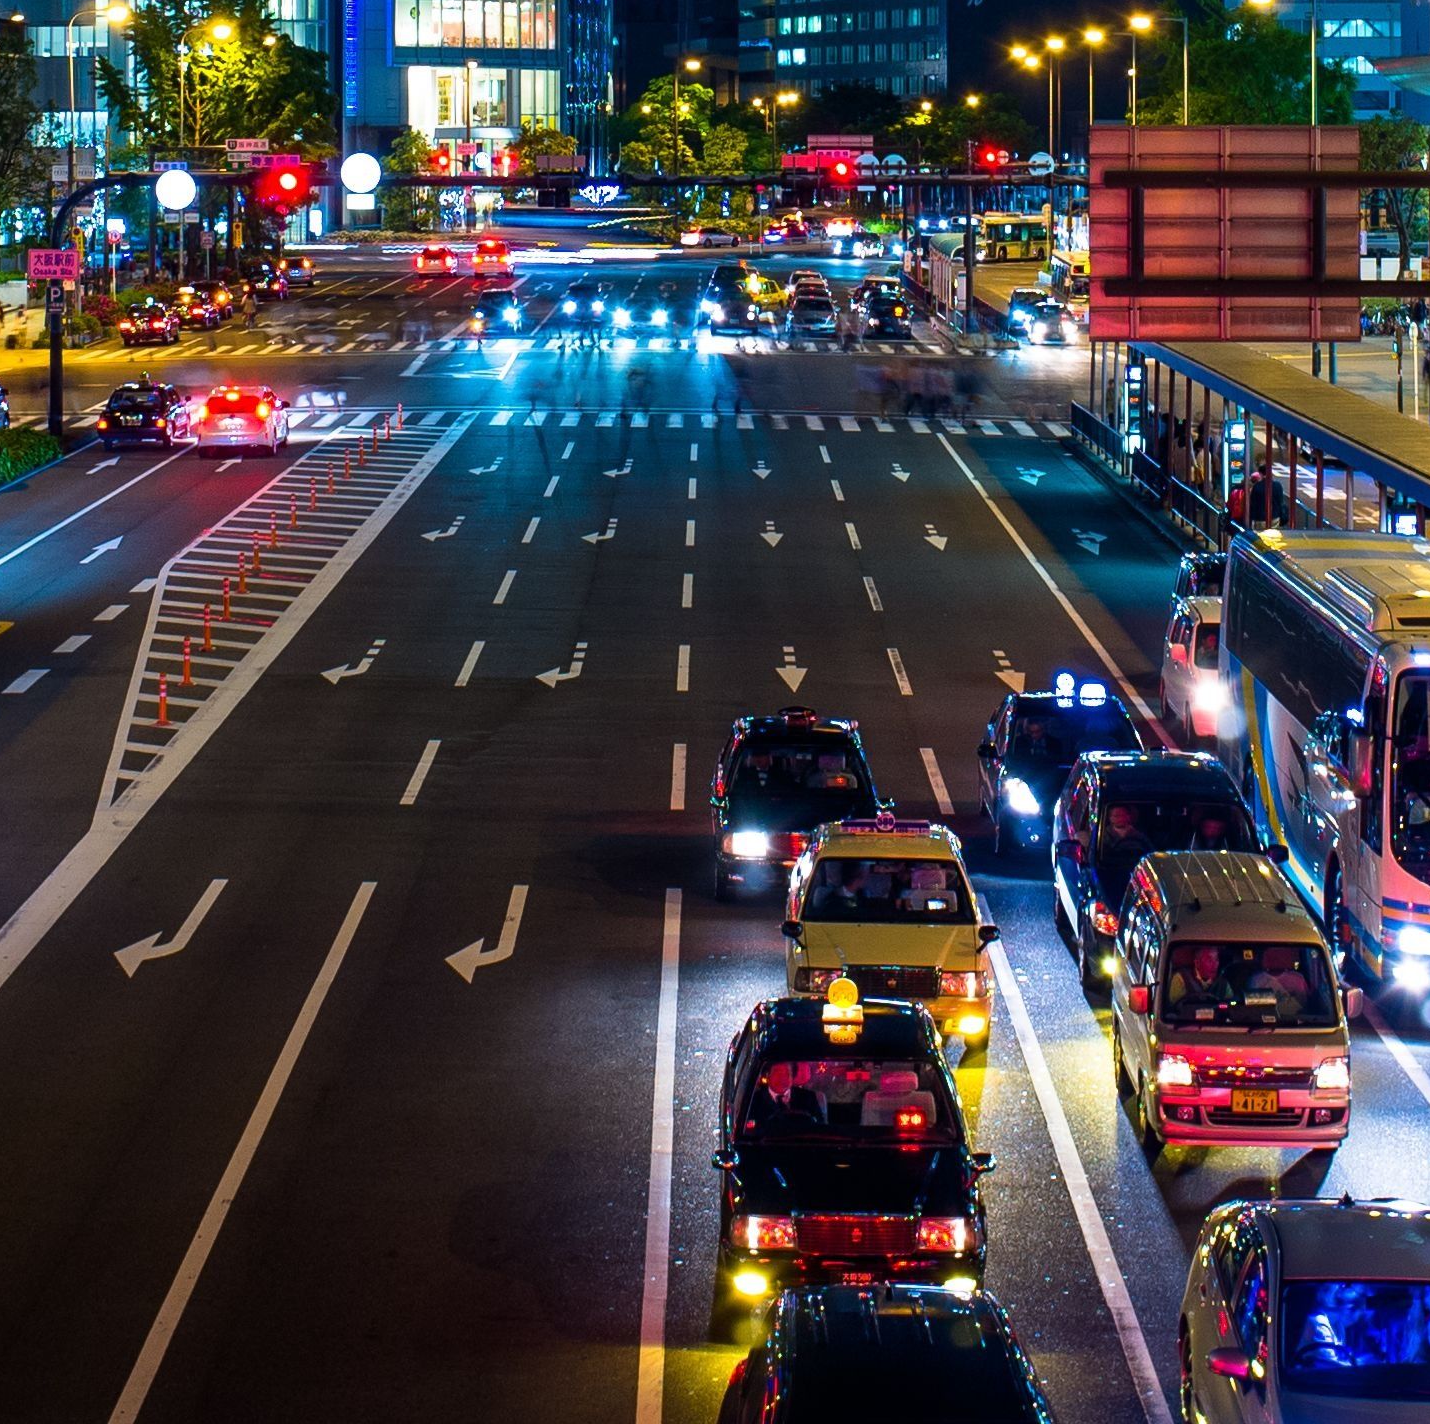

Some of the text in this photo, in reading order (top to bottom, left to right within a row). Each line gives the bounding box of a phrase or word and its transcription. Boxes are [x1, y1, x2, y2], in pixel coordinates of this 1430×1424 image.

[33, 253, 75, 267] 大阪駅前
[33, 267, 58, 276] Osaka
[50, 287, 61, 302] P
